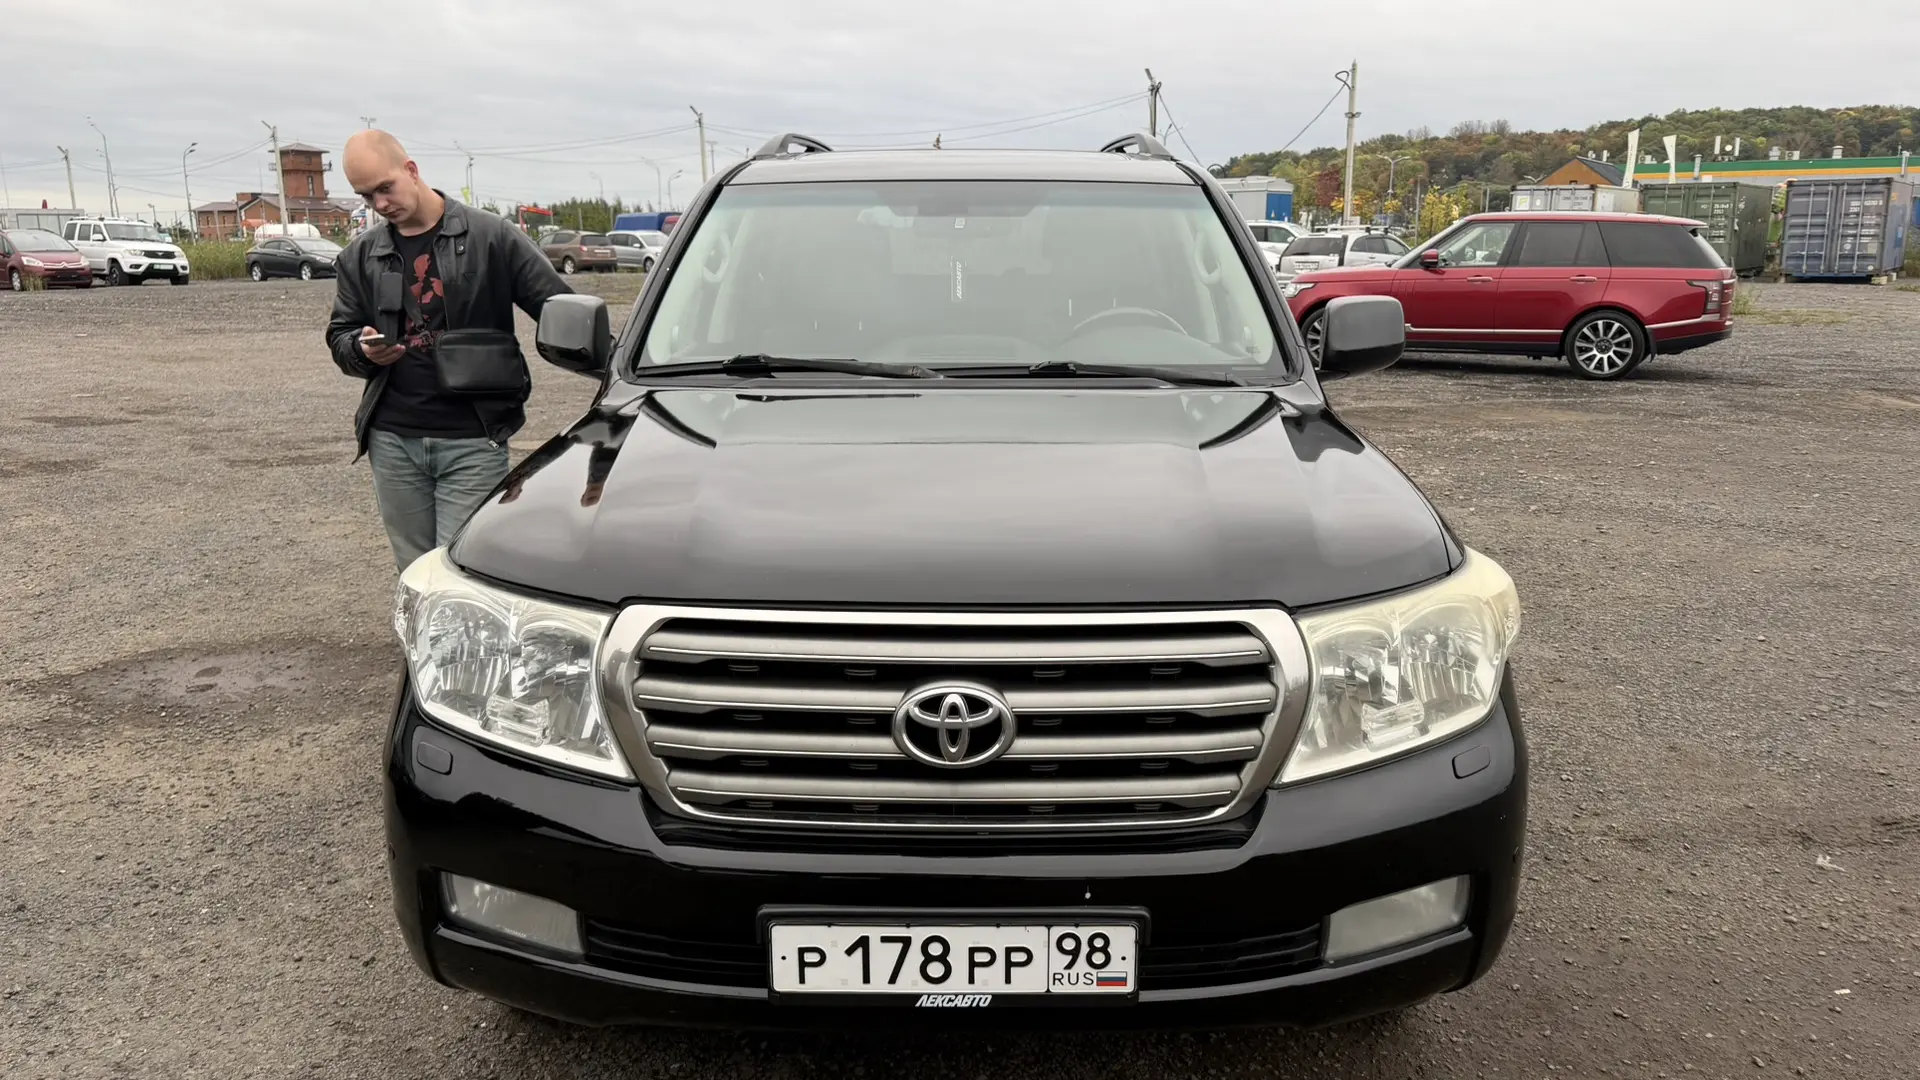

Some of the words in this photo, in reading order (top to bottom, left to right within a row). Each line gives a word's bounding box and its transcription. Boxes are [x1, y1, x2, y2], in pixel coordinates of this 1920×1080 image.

[1056, 932, 1112, 970] 98
[1053, 973, 1094, 985] RUS
[915, 994, 992, 1007] ЛЕКСАВТО
